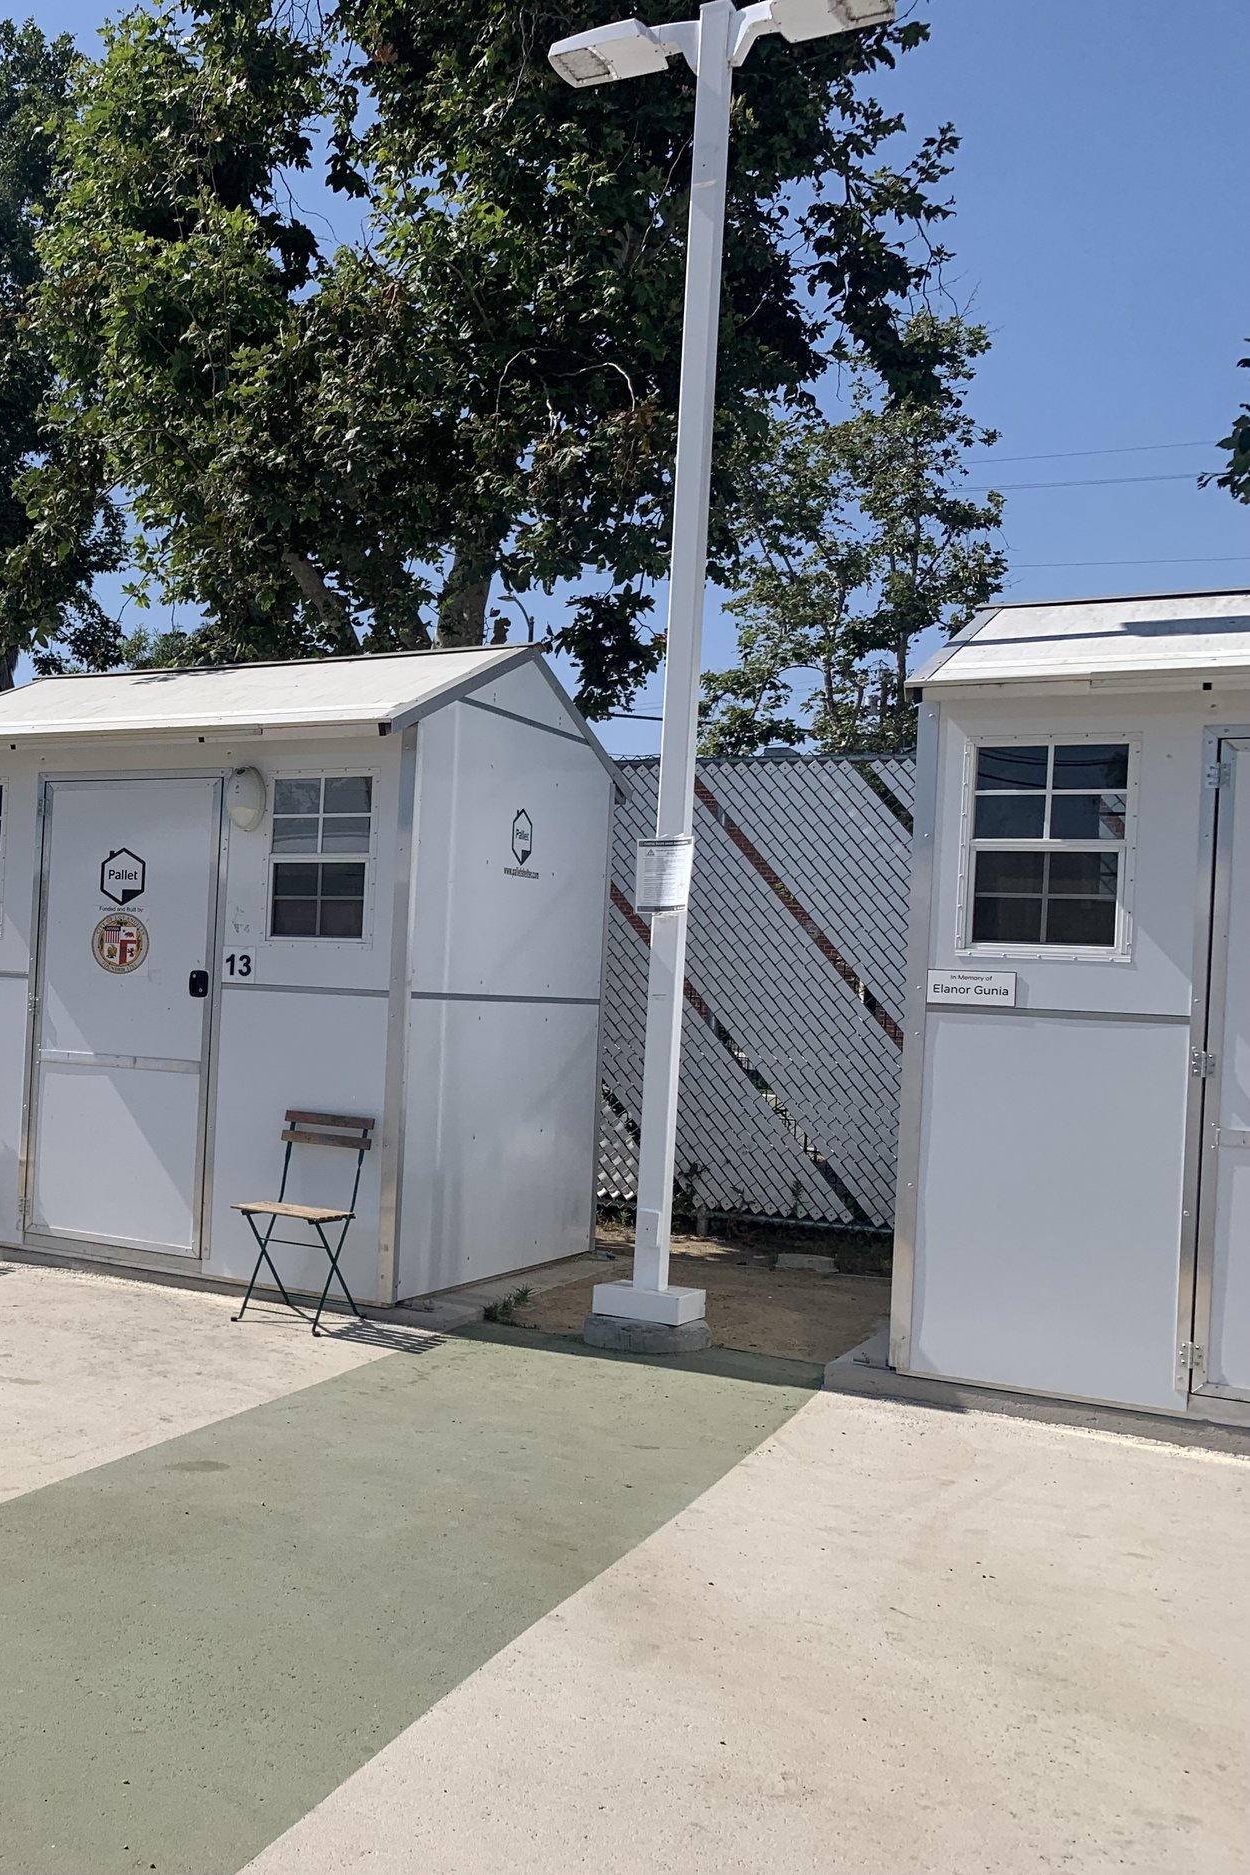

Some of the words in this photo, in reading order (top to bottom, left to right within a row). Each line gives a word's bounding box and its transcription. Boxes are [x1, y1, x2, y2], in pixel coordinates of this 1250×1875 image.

[515, 828, 530, 841] Pallet
[108, 869, 138, 880] Pallet
[225, 953, 252, 977] 13
[933, 983, 971, 994] Elanor
[973, 985, 1009, 996] Gunia
